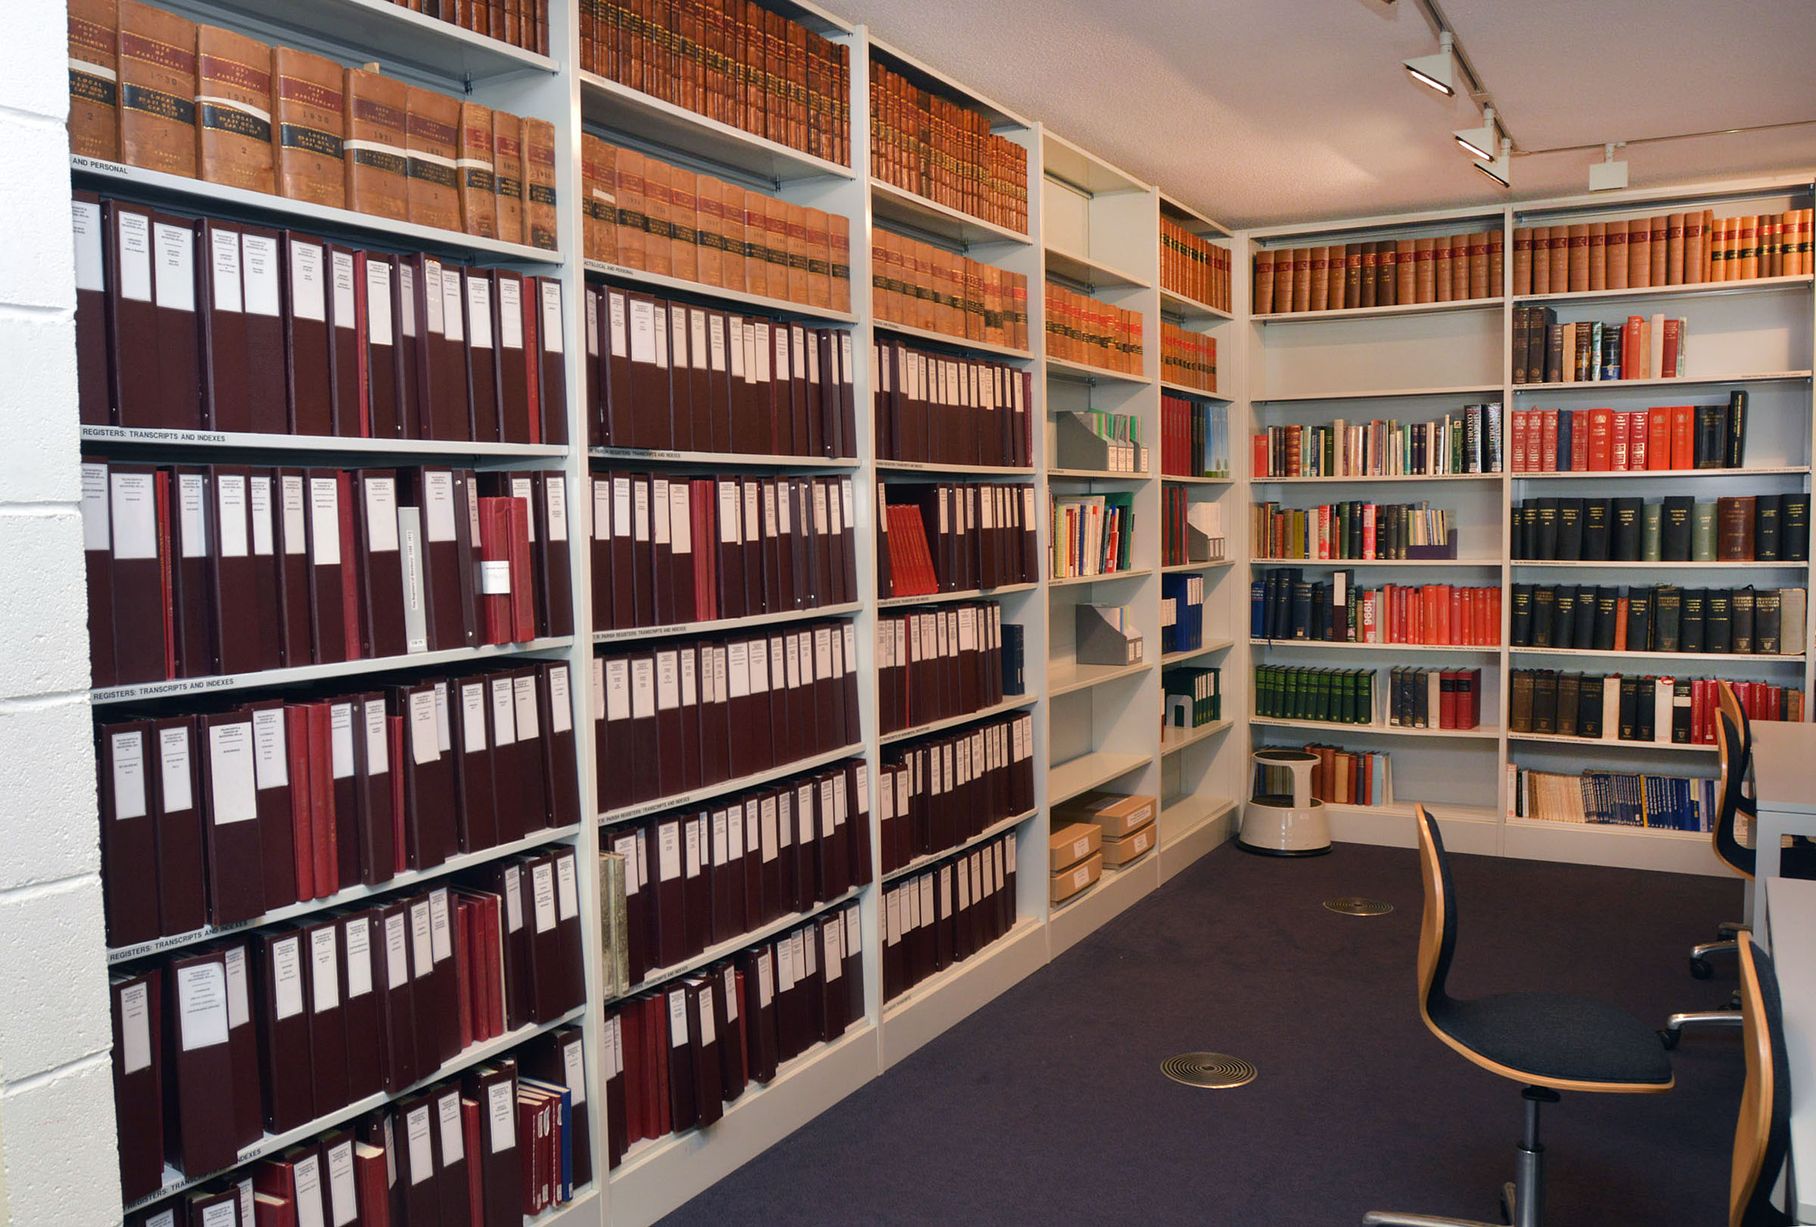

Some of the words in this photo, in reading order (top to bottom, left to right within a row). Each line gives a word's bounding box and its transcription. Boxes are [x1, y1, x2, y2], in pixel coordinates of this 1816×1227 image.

[72, 158, 88, 166] AND
[90, 161, 128, 174] PERSONAL
[82, 428, 126, 438] REGISTERS:
[130, 430, 178, 440] TRANSCRIPTS
[93, 690, 137, 700] REGISTERS:
[140, 684, 188, 695] TRANSCRIPTS
[206, 678, 234, 688] INDEXES
[110, 946, 153, 961] REGISTERS:
[155, 931, 202, 950] TRANSCRIPTS
[204, 926, 219, 937] AND
